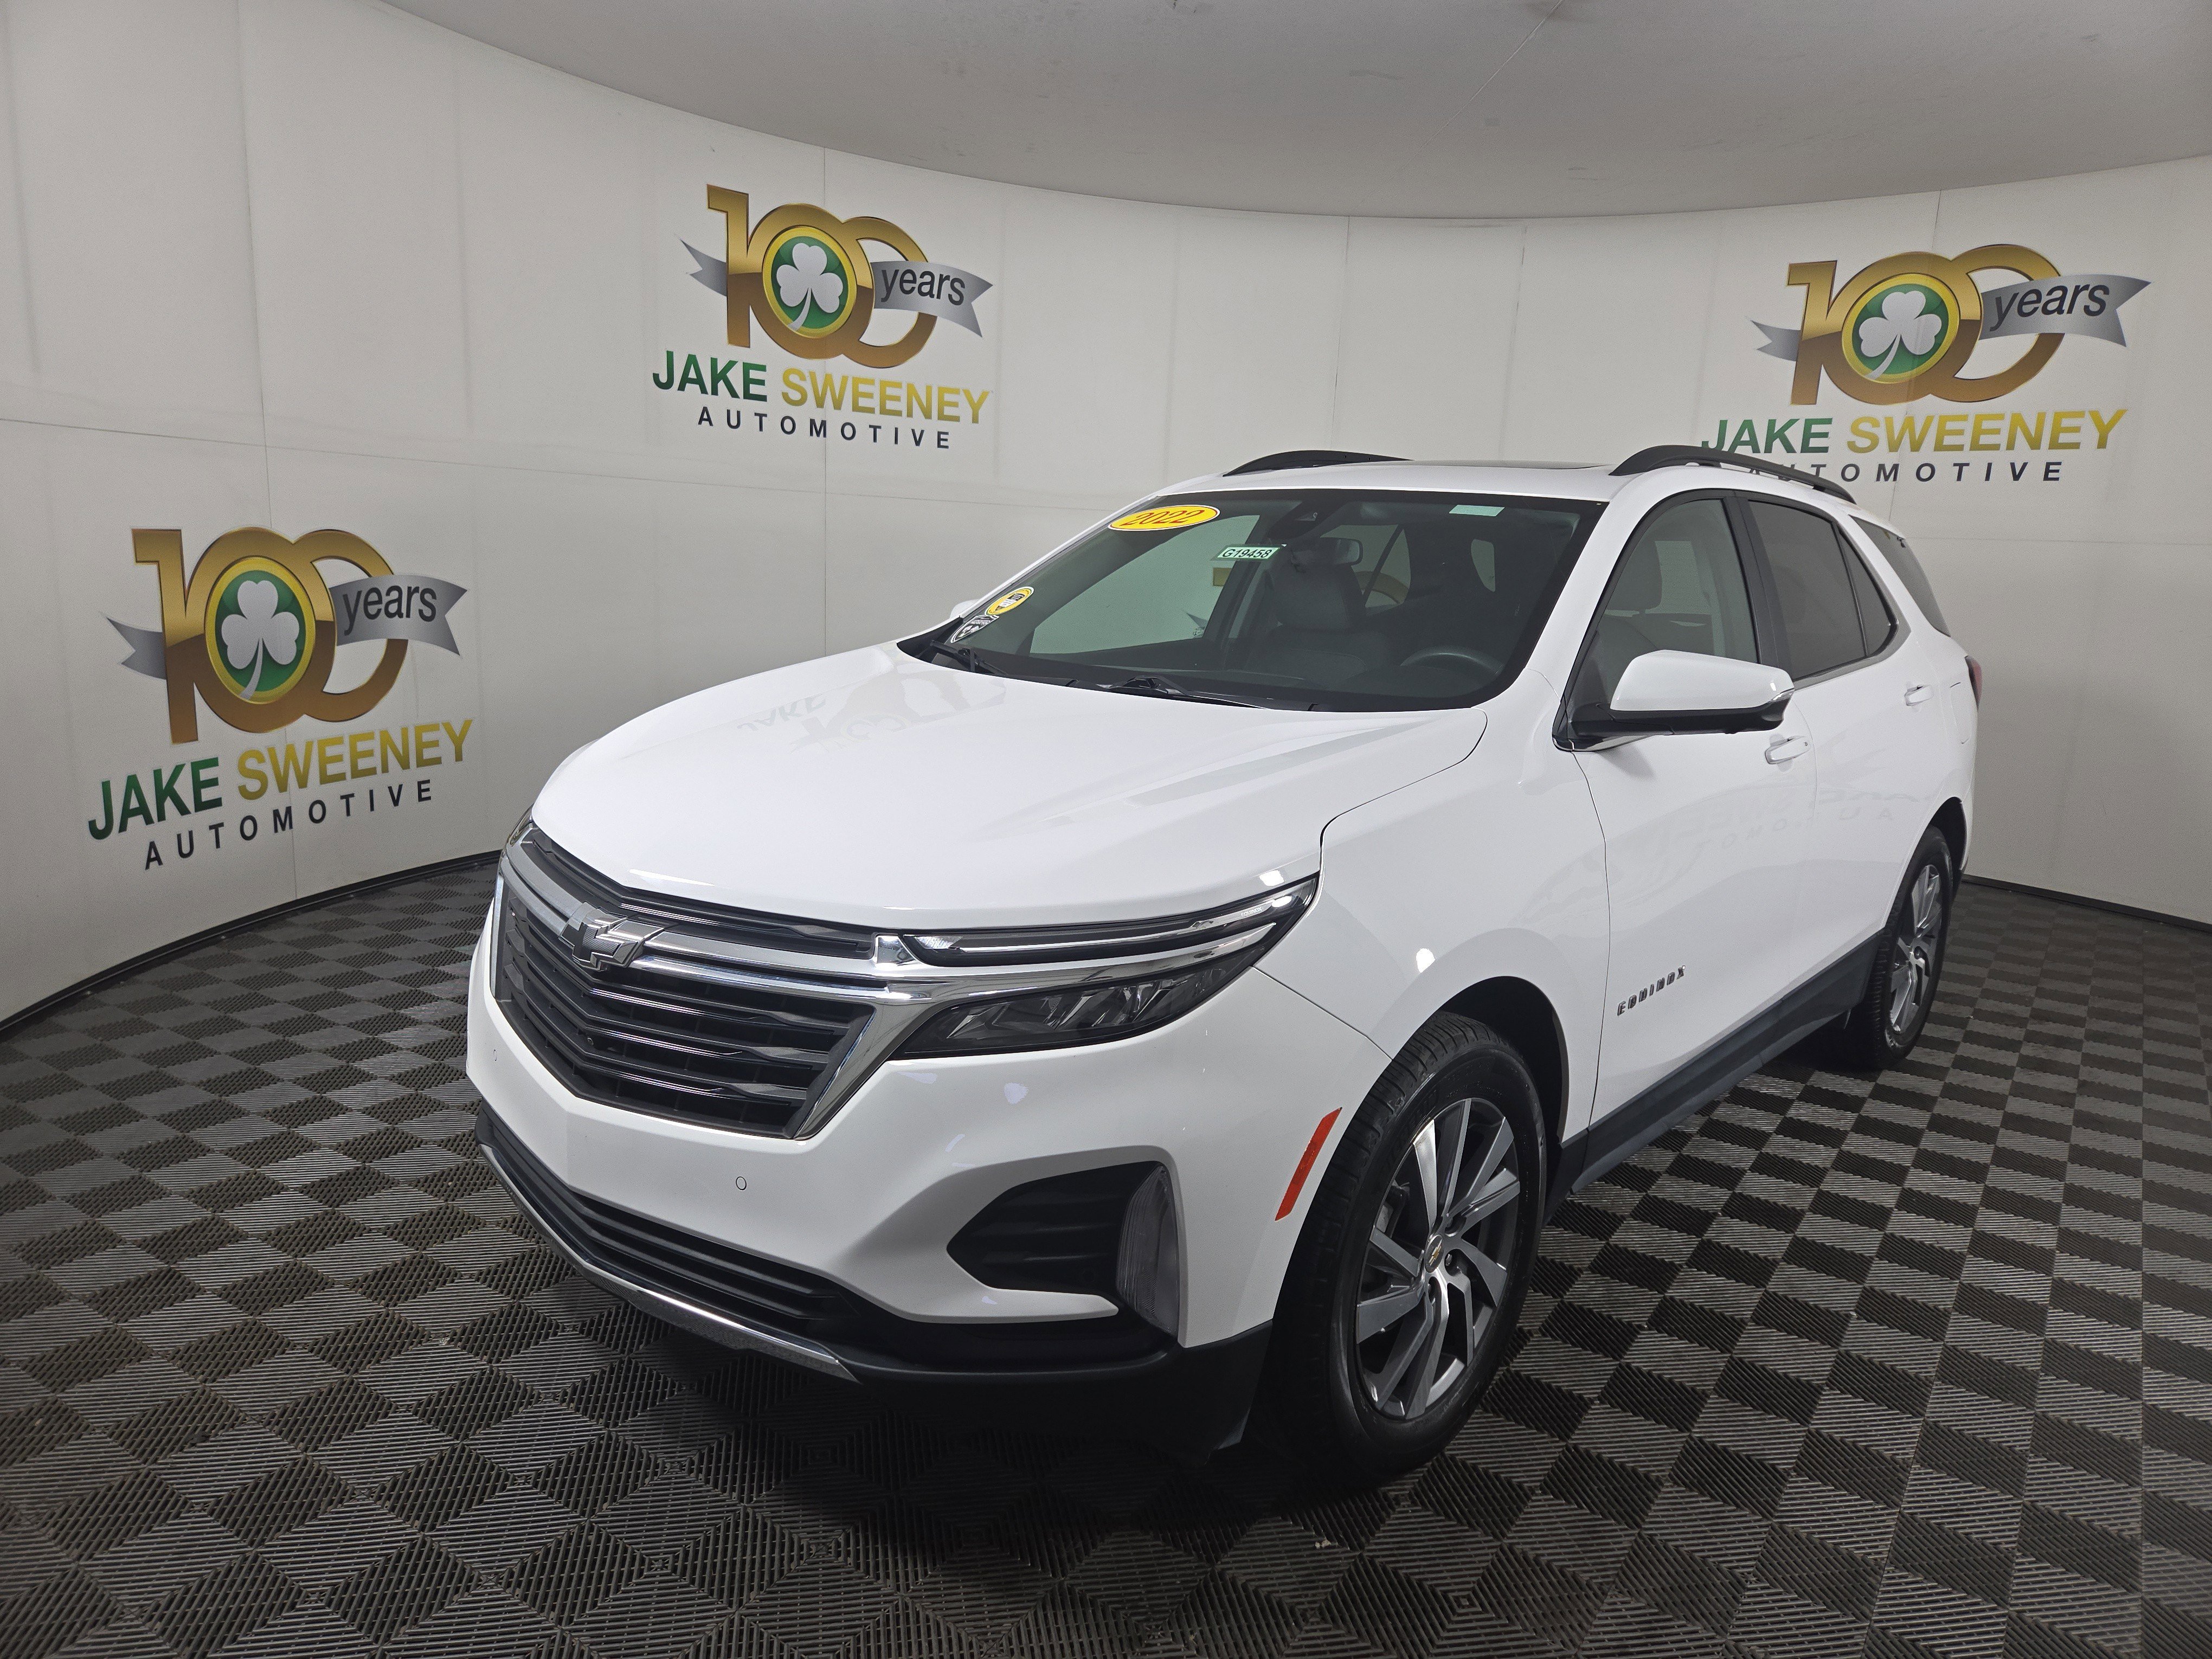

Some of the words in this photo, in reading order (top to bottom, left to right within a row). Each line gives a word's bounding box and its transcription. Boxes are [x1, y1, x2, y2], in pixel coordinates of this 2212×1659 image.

[880, 269, 966, 305] years
[1989, 283, 2110, 332] years
[652, 350, 768, 402] JAKE
[781, 367, 990, 424] SWEENEY
[698, 406, 949, 449] AUTOMOTIVE
[1701, 418, 1832, 454] JAKE
[1847, 409, 2128, 453] SWEENEY
[1750, 461, 2062, 482] TOMOTIVE
[1119, 510, 1205, 526] 2022
[1222, 549, 1272, 558] G19458
[343, 584, 437, 635] years
[88, 757, 223, 840] JAKE
[237, 719, 473, 800] SWEENEY
[144, 779, 432, 871] AUTOMOTIVE
[1617, 965, 1686, 1016] EQUINOX
